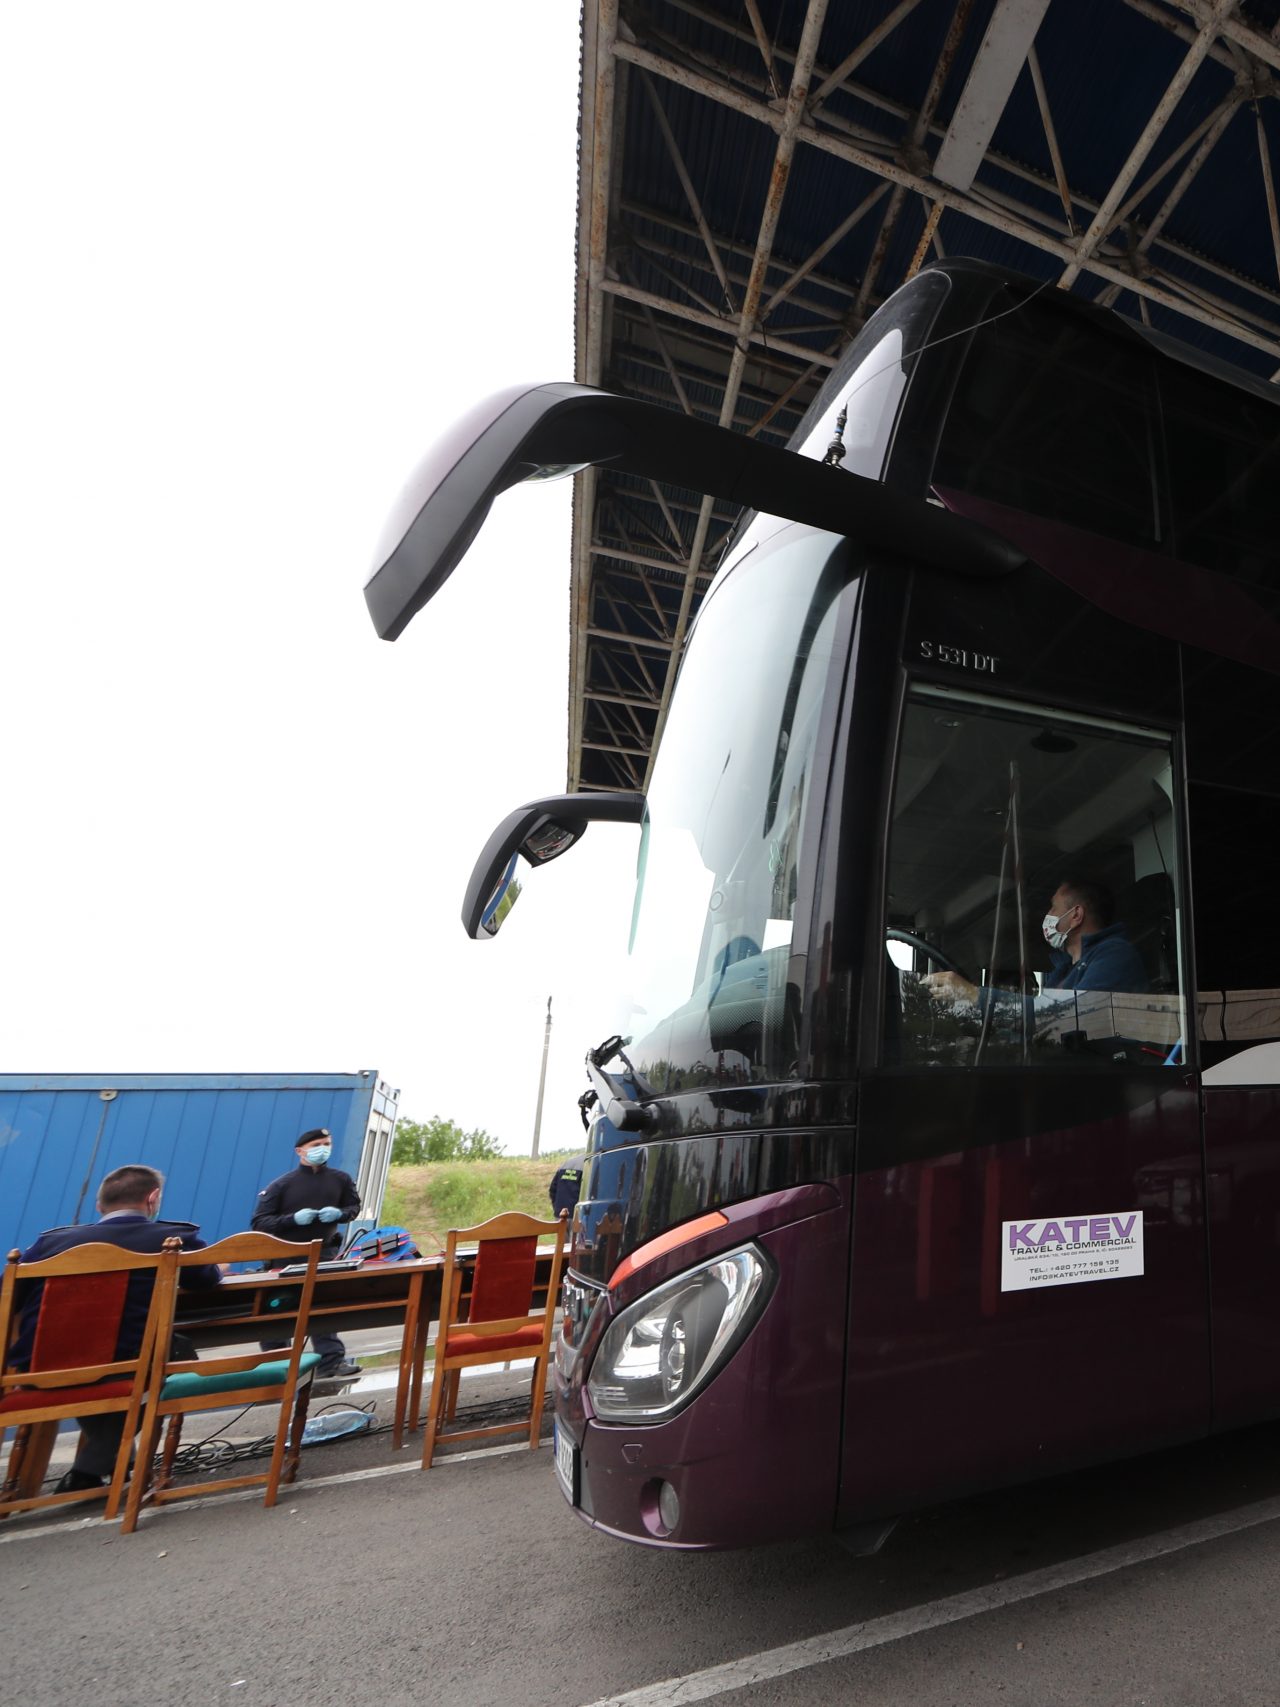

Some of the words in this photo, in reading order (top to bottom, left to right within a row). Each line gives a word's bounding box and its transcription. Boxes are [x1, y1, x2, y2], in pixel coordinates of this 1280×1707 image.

[920, 640, 932, 658] S
[939, 644, 968, 667] 531
[973, 651, 1000, 673] DT
[1009, 1215, 1137, 1249] KATEV
[1010, 1245, 1053, 1255] TRAVEL
[1066, 1237, 1136, 1250] COMMERCIAL
